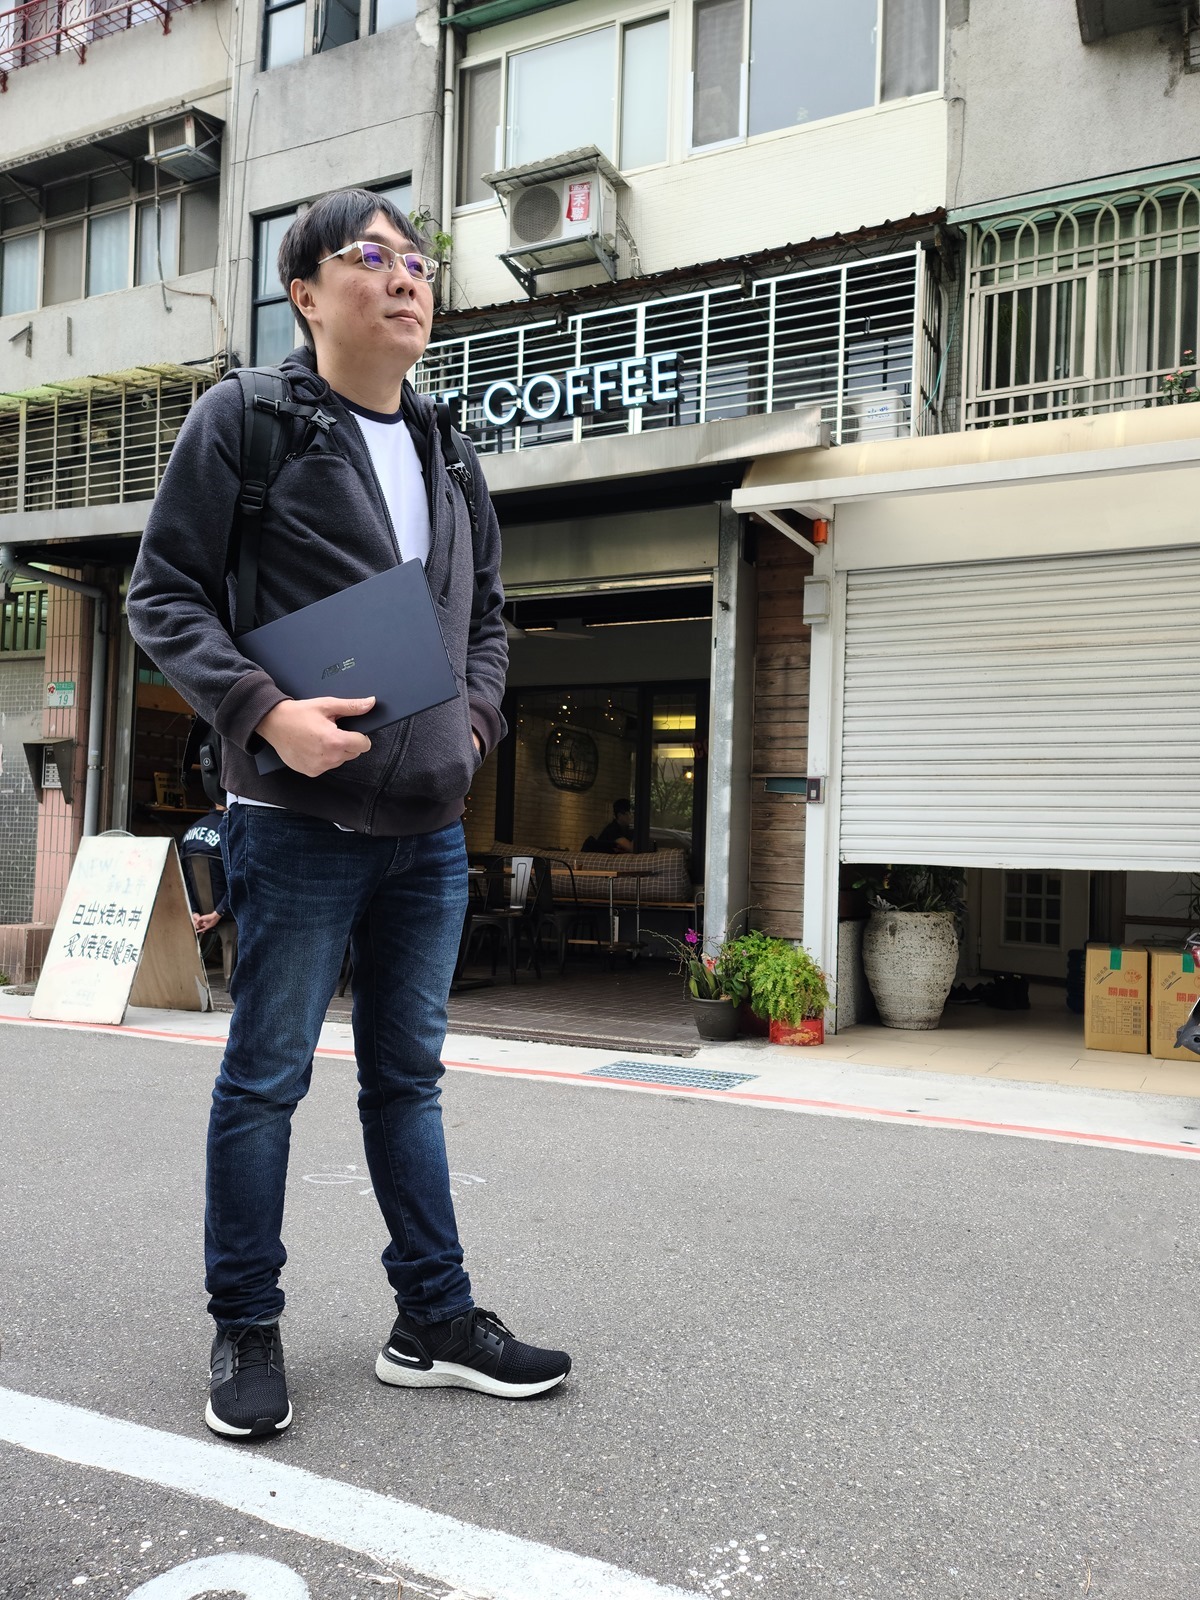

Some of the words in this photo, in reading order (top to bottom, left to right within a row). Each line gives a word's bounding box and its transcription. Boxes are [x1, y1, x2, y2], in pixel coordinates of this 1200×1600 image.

[483, 352, 678, 425] COFFEE
[59, 694, 68, 705] 19
[183, 826, 208, 843] NIKE
[204, 829, 221, 847] SB
